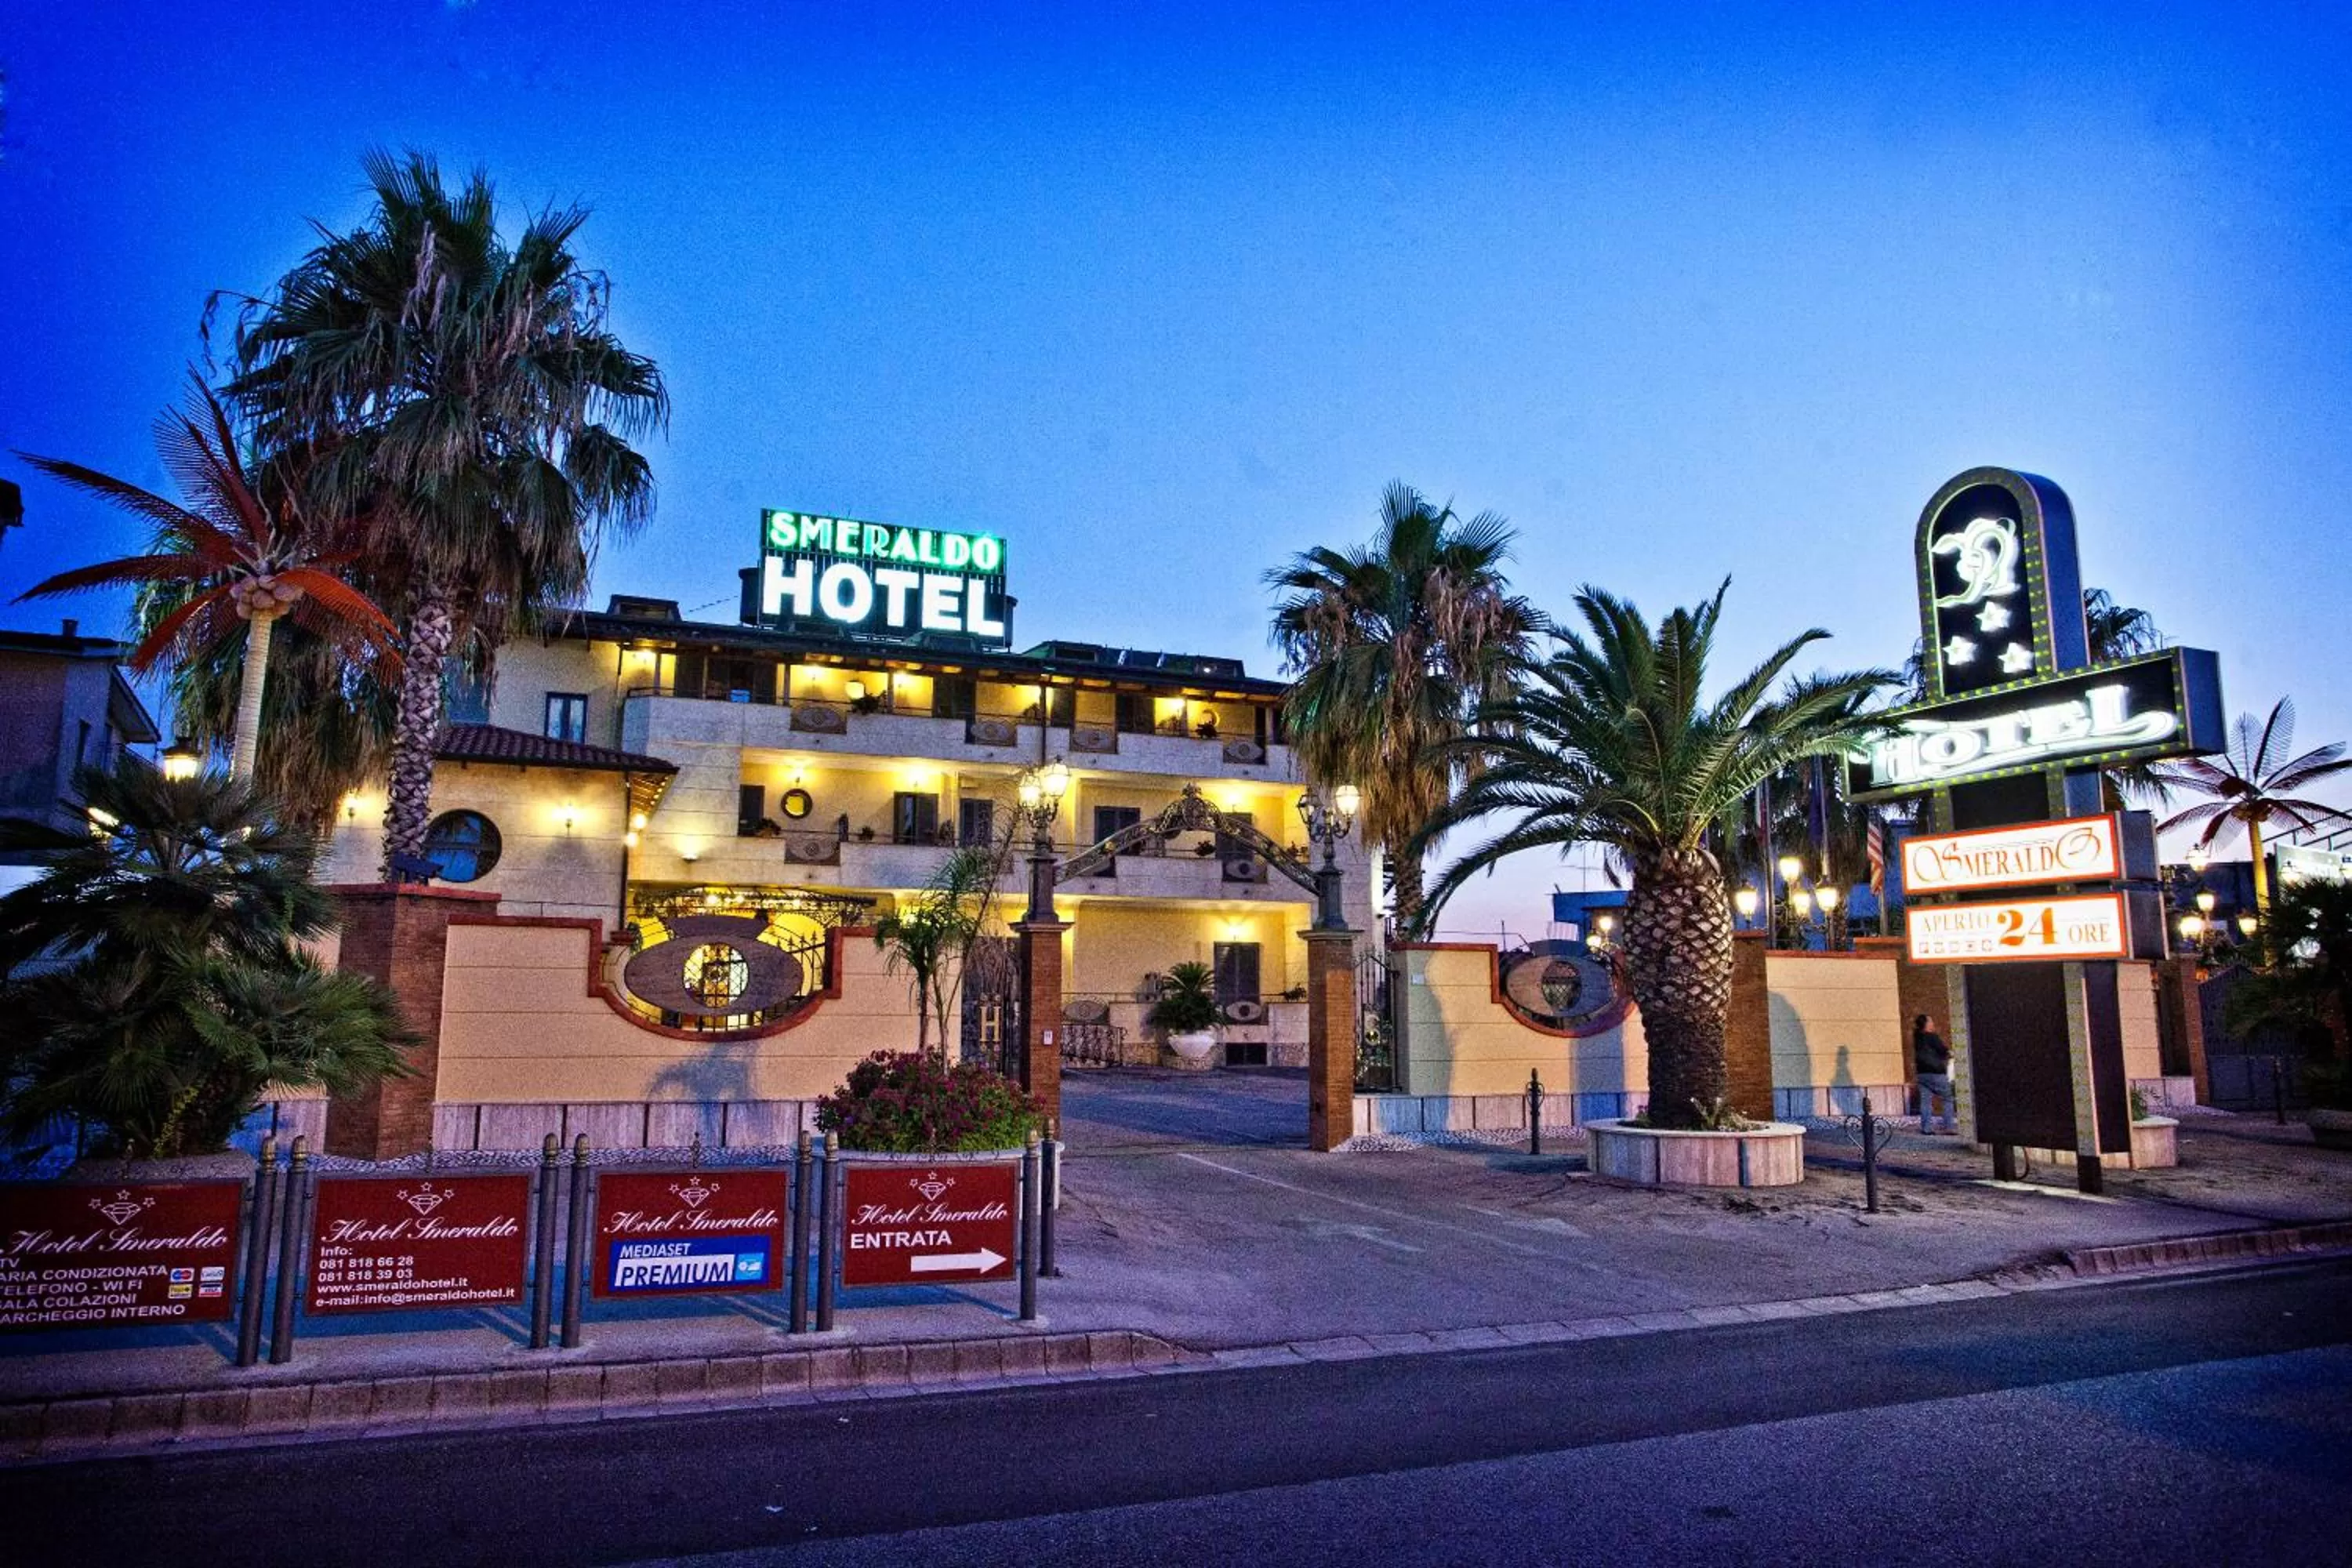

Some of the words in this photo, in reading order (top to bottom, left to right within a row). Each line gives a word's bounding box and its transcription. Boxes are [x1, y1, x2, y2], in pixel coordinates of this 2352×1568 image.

[769, 510, 1000, 571] SMERALDO
[761, 555, 1004, 637] HOTEL
[1871, 684, 2179, 787] HOTEL
[1913, 827, 2102, 883] SMERALDO
[1922, 911, 1991, 932] APERTO
[1997, 907, 2060, 946] 24
[2068, 922, 2112, 944] ORE
[603, 1210, 684, 1233] Hotel
[680, 1207, 779, 1230] Smeraldo
[851, 1203, 924, 1225] Hotel
[920, 1201, 1007, 1223] Smeraldo
[321, 1218, 413, 1242] Hotel
[407, 1215, 519, 1240] Smeraldo
[0, 1229, 103, 1254] Hotel
[99, 1225, 227, 1252] Smeraldo
[851, 1230, 953, 1249] ENTRATA
[321, 1246, 353, 1257] Info:
[619, 1243, 691, 1258] MEDIASET
[319, 1258, 343, 1269] 081
[348, 1258, 372, 1268] 818
[377, 1257, 394, 1267] 66
[397, 1255, 414, 1266] 28
[42, 1264, 168, 1280] CONDIZIONATA
[318, 1272, 343, 1283] 081
[347, 1270, 372, 1281] 818
[376, 1269, 393, 1279] 39
[396, 1268, 413, 1279] 03
[620, 1261, 730, 1287] PREMIUM
[103, 1280, 124, 1291] WI
[128, 1279, 142, 1290] FI
[317, 1277, 468, 1294] www.smeraldohotel.it
[43, 1294, 136, 1308] COLAZIONI
[316, 1288, 515, 1307] e-mail:info@smeraldohotel.it
[0, 1308, 106, 1324] ARCHEGGIO
[111, 1305, 185, 1319] INTERNO
